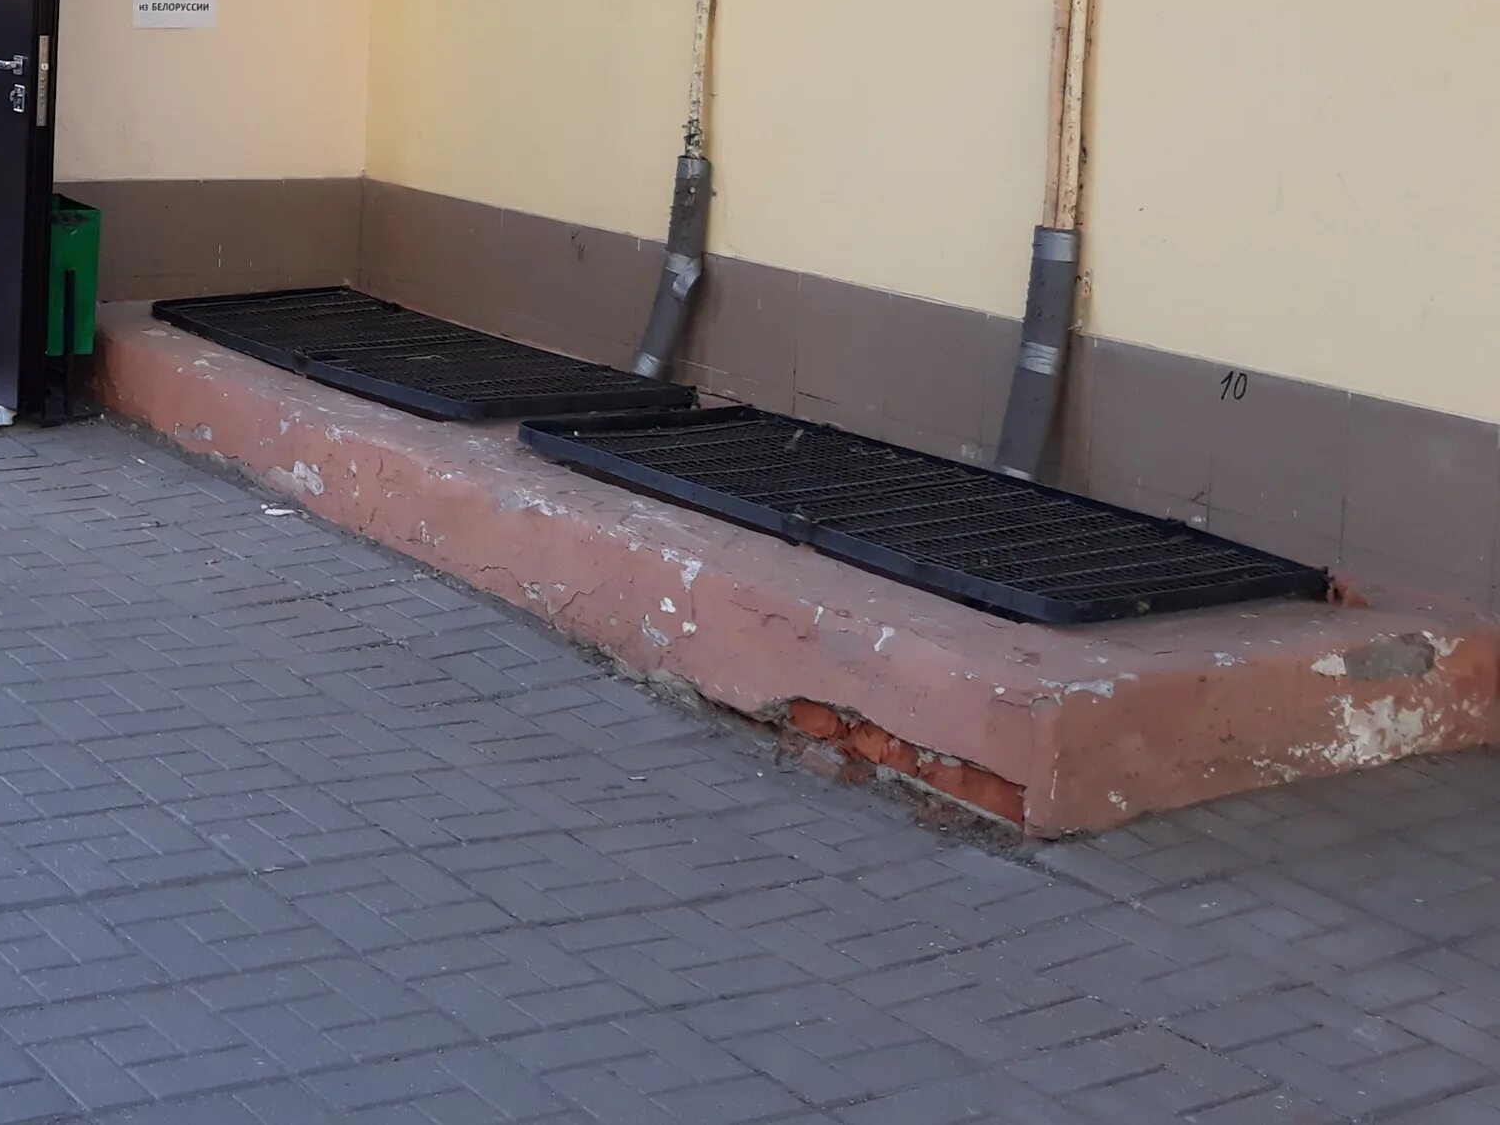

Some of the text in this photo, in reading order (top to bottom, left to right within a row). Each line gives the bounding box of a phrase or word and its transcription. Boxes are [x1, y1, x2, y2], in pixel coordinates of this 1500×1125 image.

[139, 2, 210, 11] из БЕЛОРУССИИ
[1220, 370, 1248, 401] 10
